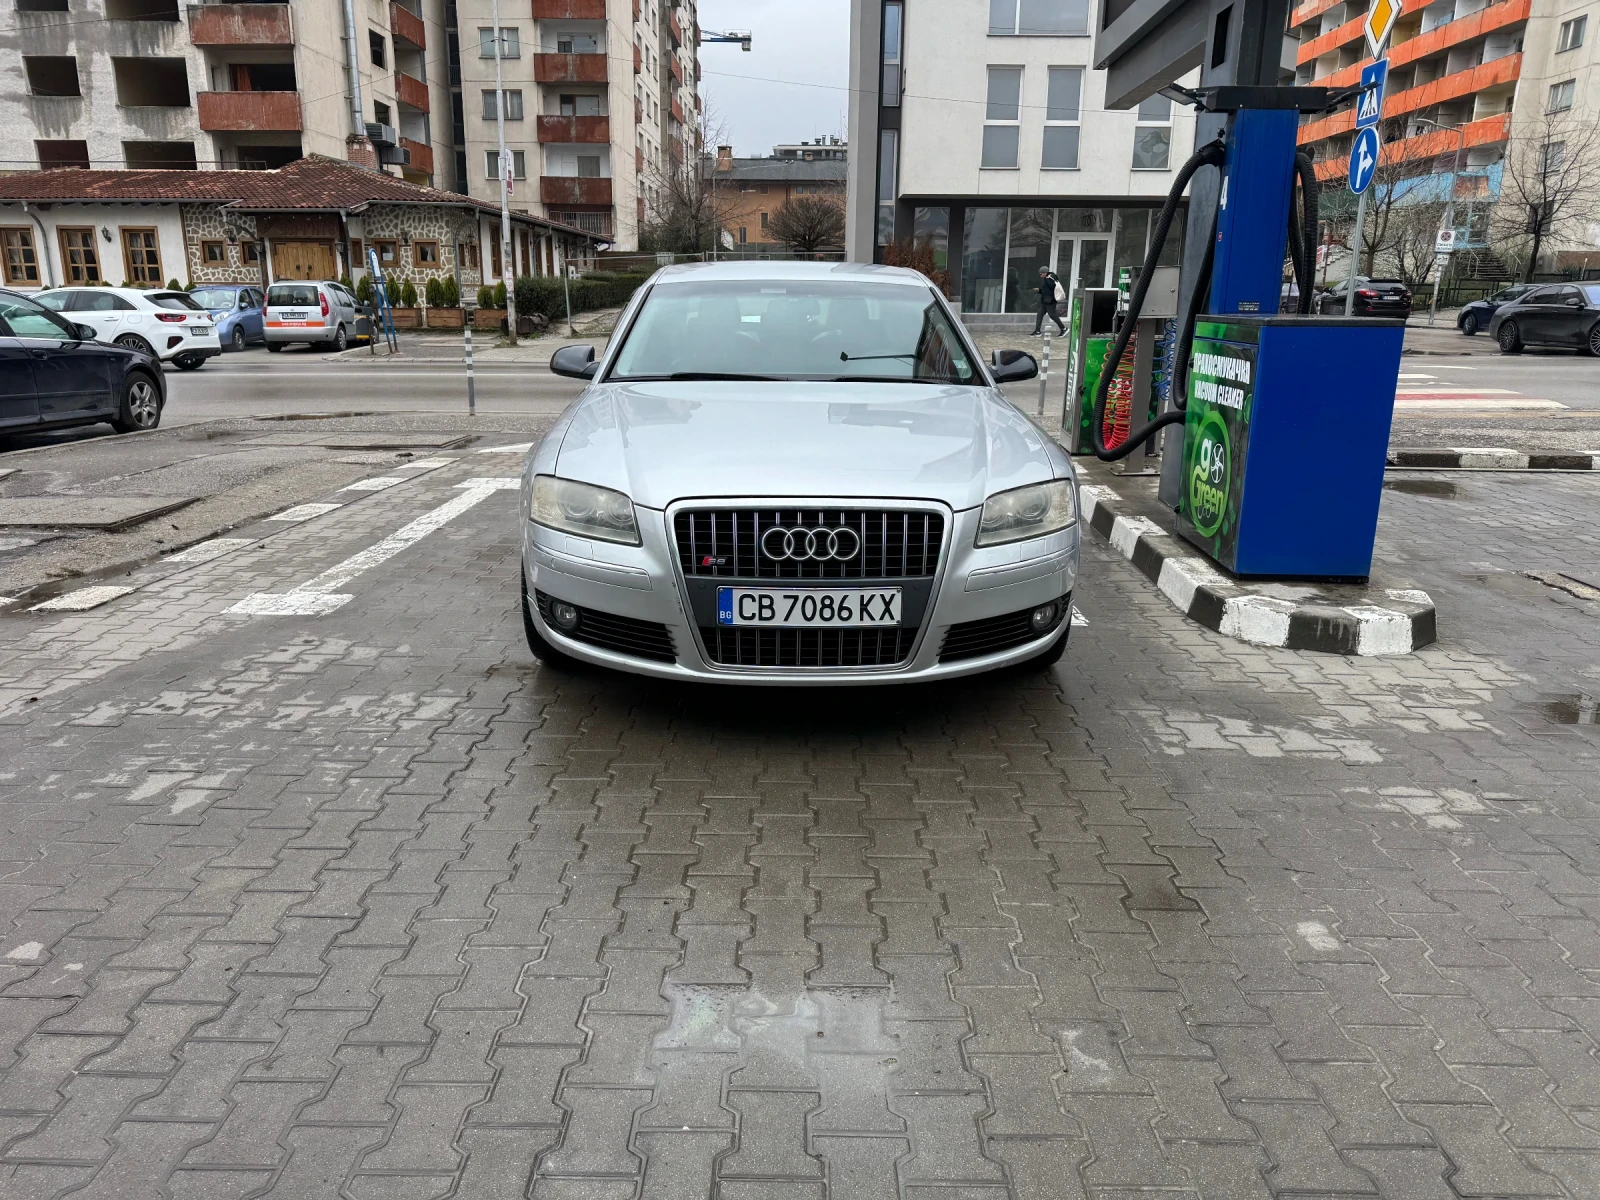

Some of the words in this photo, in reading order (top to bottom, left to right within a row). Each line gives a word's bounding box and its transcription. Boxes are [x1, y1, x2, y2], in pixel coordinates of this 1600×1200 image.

[1220, 176, 1229, 210] 4
[1193, 352, 1251, 384] ПРАХОСМУКАЧКА
[1194, 380, 1218, 403] VACUUM
[1217, 385, 1244, 410] CLEANER
[719, 610, 732, 619] BG
